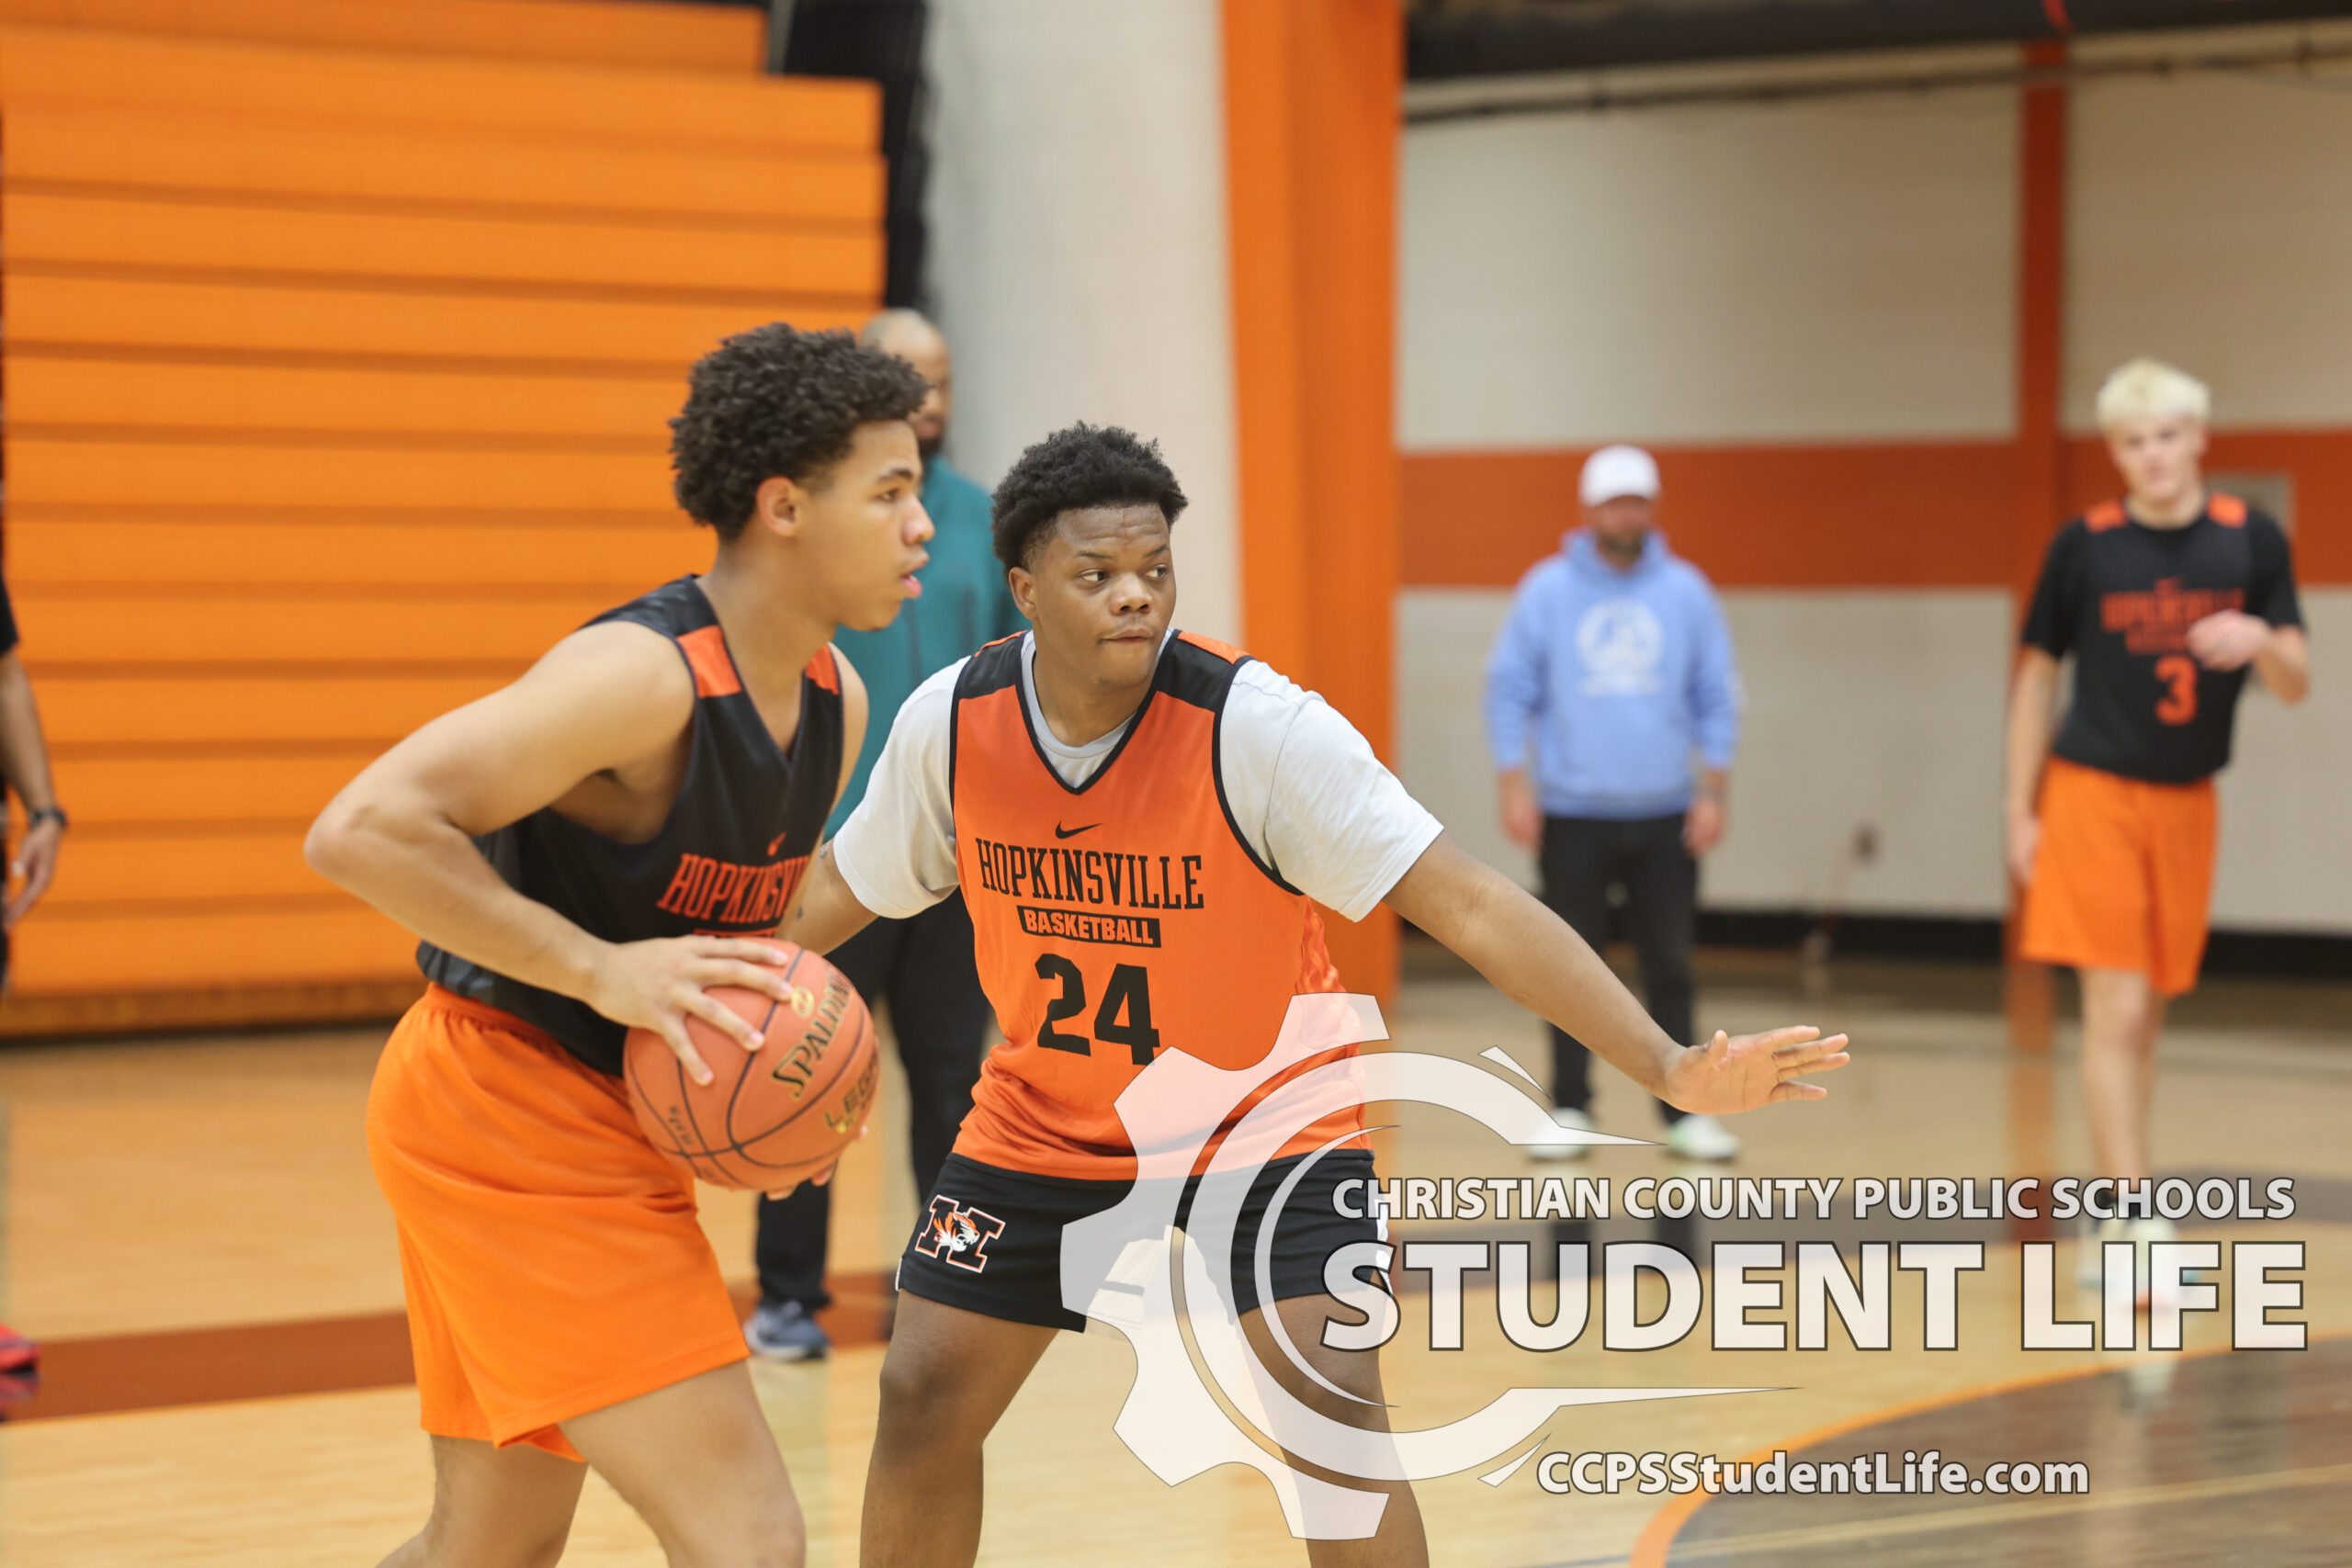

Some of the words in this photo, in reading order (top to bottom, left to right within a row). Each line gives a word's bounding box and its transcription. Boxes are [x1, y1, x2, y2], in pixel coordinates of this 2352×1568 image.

[2154, 656, 2199, 726] 3
[975, 837, 1204, 909] HOPKINSVILLE
[1022, 908, 1154, 945] BASKETBALL
[1035, 953, 1160, 1066] 24
